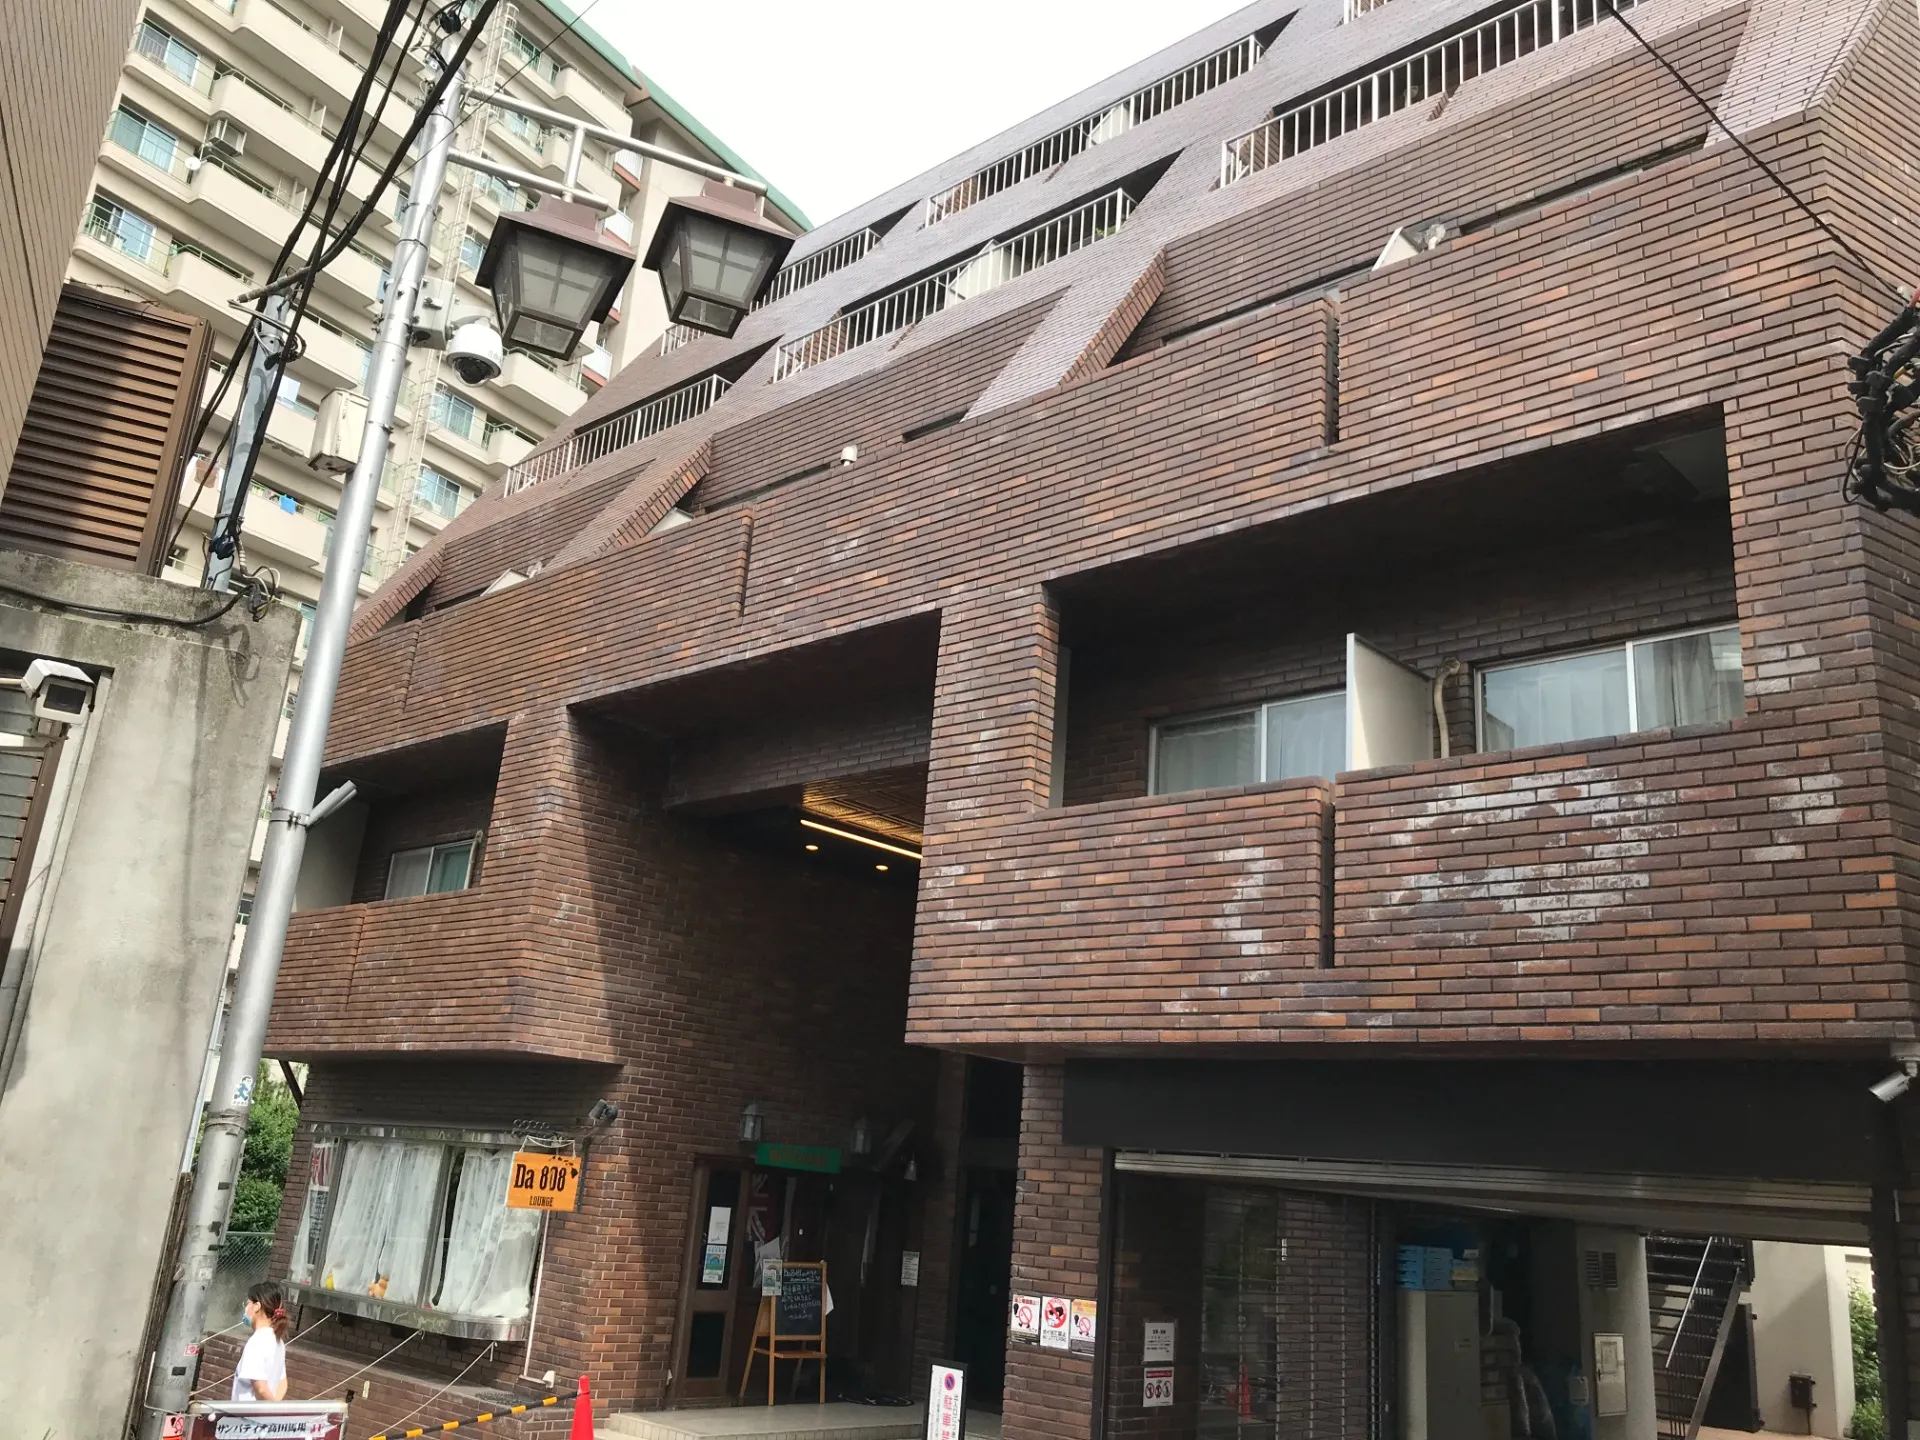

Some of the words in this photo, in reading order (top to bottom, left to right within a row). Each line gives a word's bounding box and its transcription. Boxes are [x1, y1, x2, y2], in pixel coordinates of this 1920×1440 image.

[513, 1163, 535, 1190] Da
[539, 1165, 567, 1192] 808
[529, 1195, 554, 1207] LOUNGE
